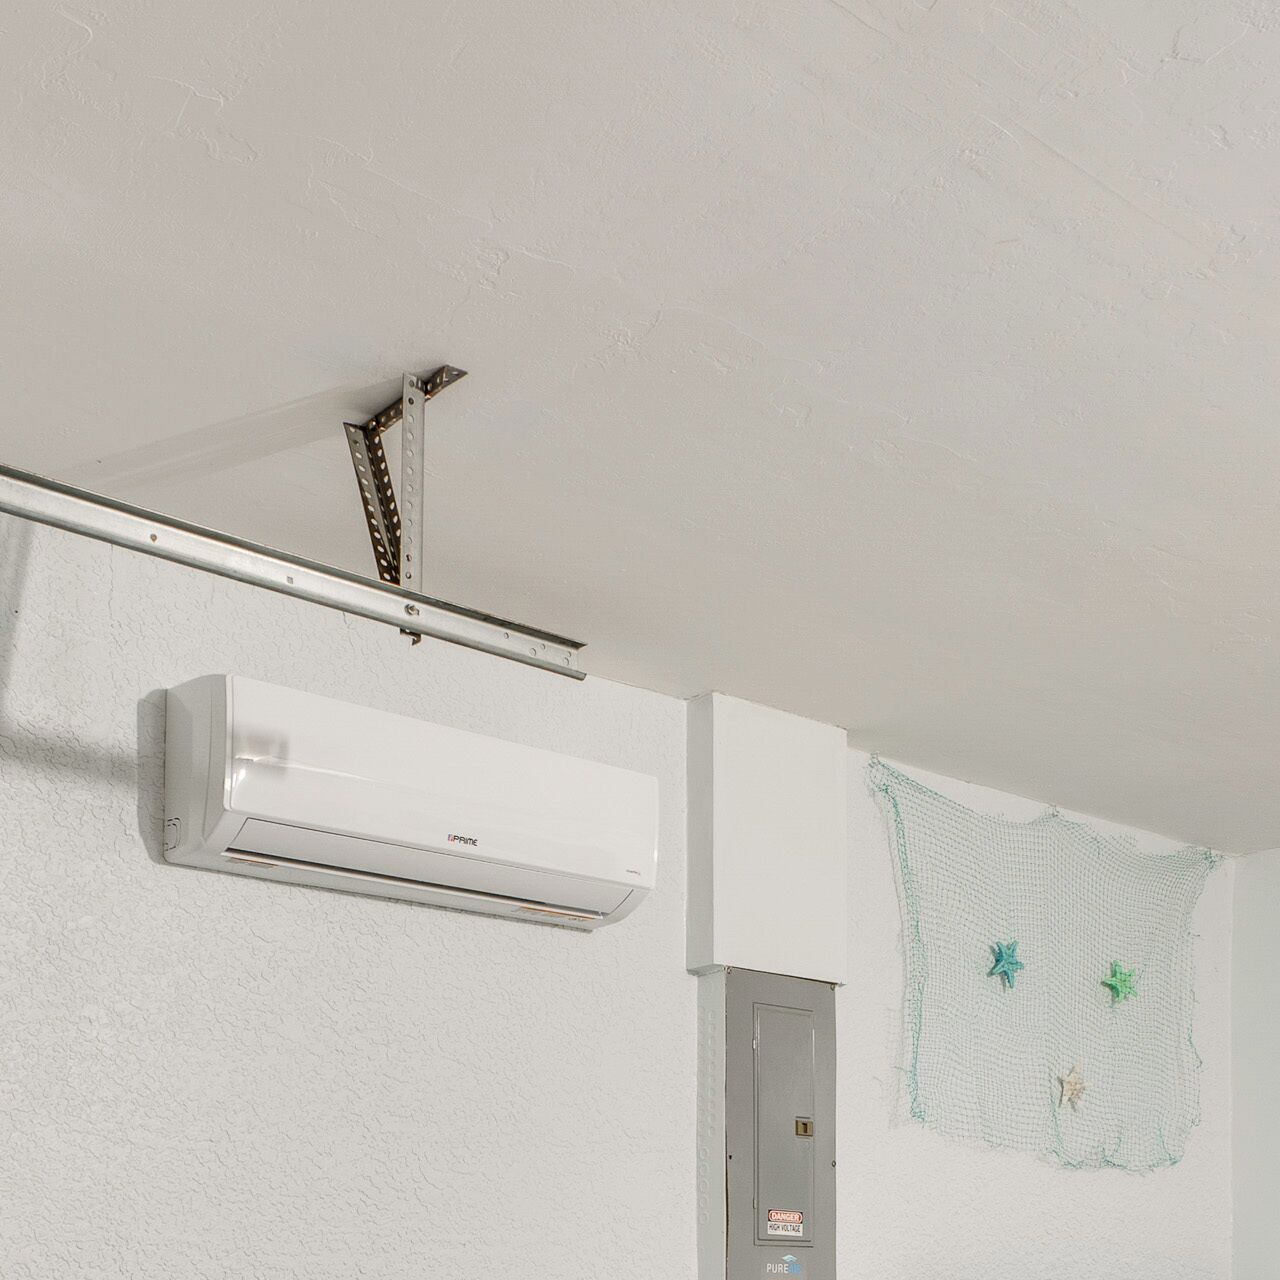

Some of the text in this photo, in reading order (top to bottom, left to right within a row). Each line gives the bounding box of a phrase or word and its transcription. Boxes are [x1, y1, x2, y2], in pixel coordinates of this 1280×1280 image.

[771, 1212, 800, 1222] DANGER
[769, 1223, 801, 1233] HIGH VOLTAGE
